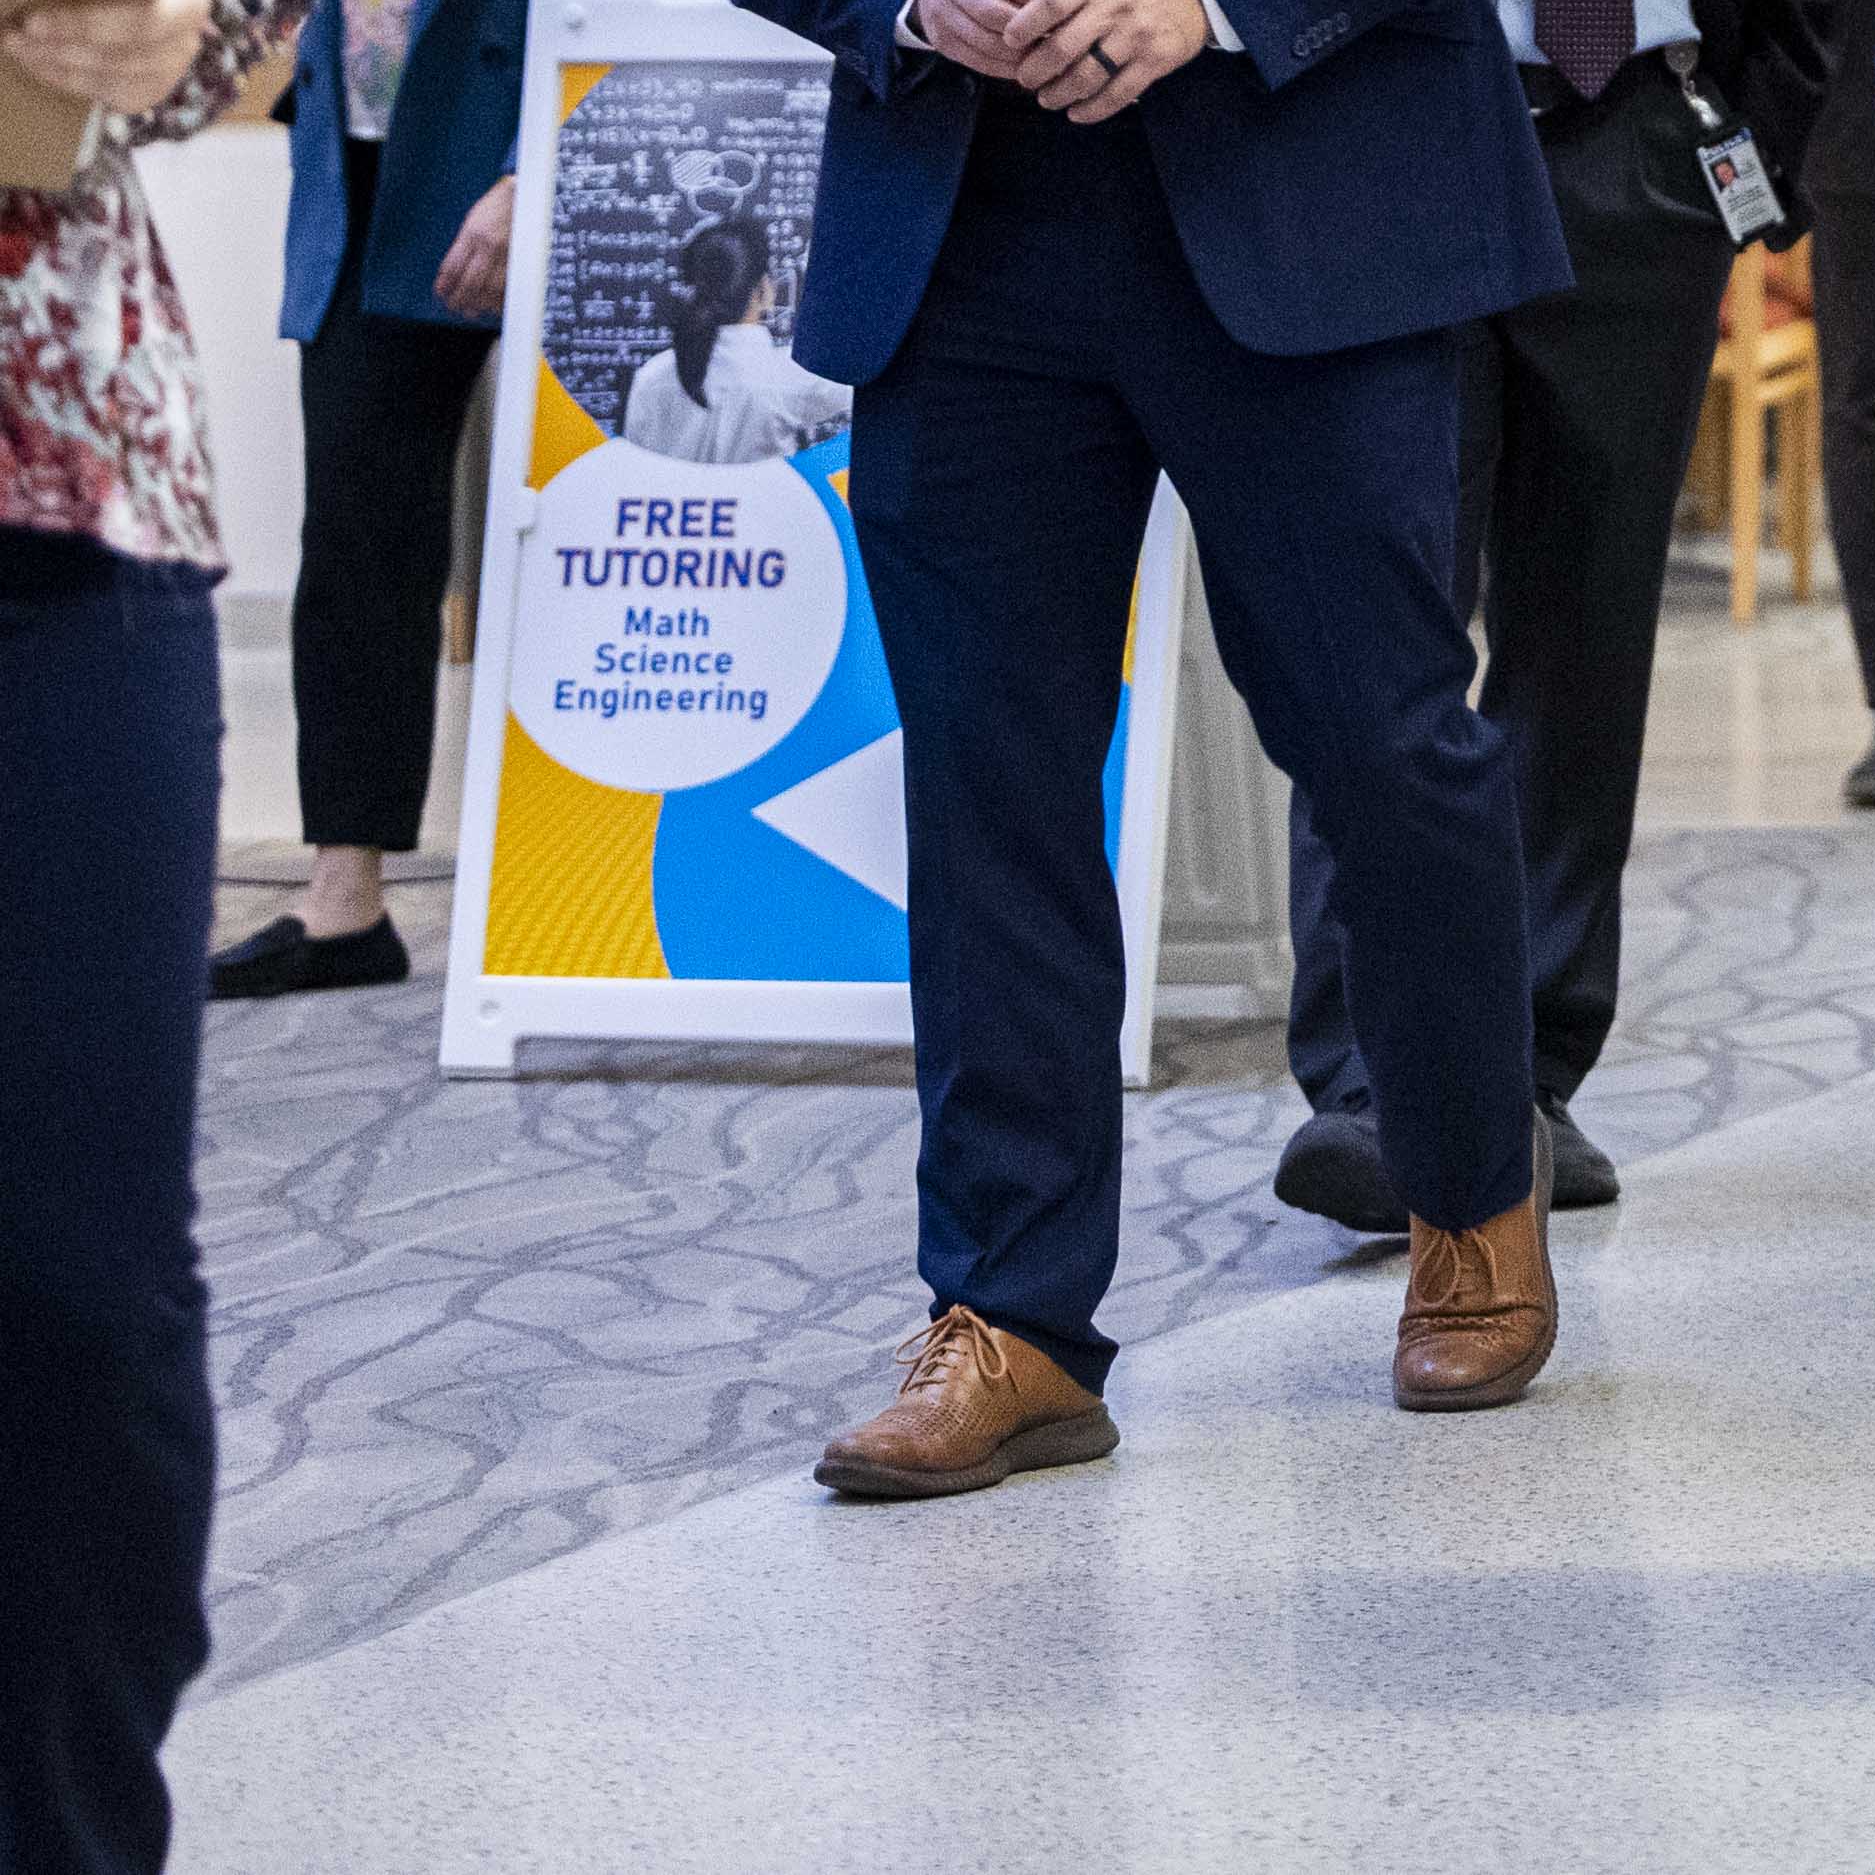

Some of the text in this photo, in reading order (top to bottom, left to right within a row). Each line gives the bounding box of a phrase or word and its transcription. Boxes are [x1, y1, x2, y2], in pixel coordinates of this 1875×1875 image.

[616, 498, 738, 538] FREE
[556, 547, 786, 589] TUTORING
[623, 606, 710, 637] Math
[594, 642, 733, 674] Science
[553, 679, 768, 720] Engineering
